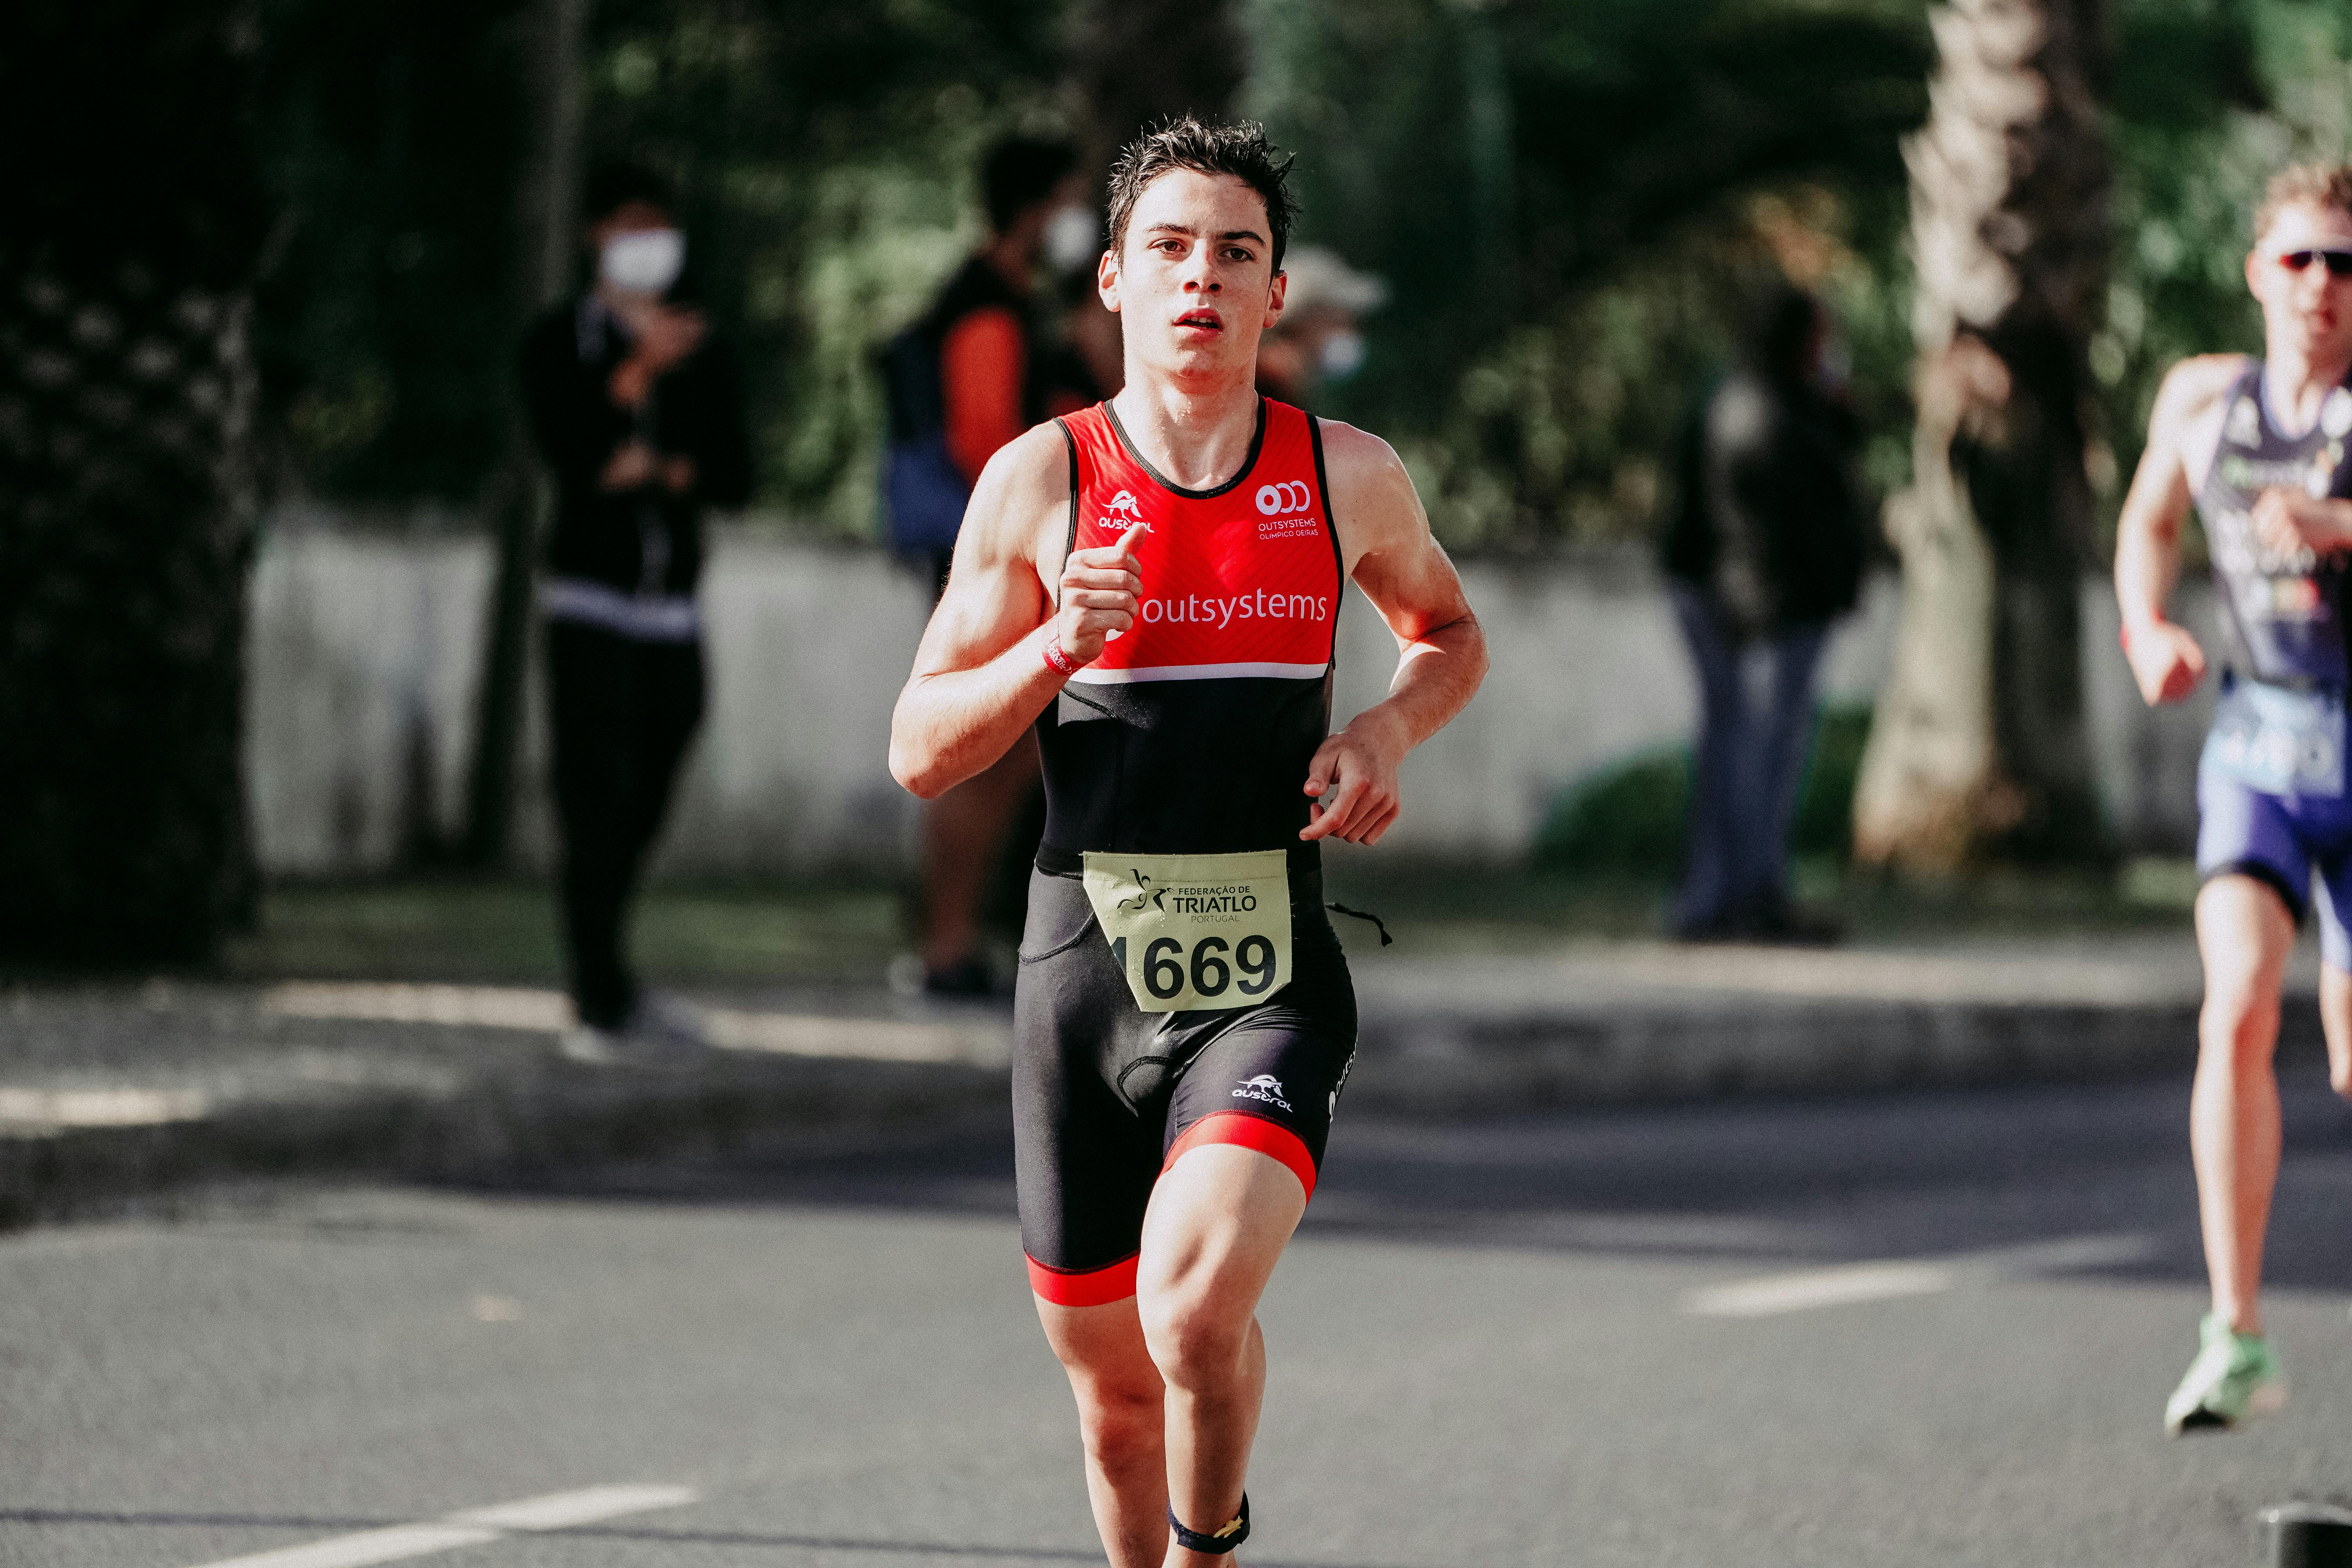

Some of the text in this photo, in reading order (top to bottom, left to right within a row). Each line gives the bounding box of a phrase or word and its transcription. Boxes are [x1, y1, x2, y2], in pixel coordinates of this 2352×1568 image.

[1099, 517, 1154, 533] austl
[1258, 518, 1316, 531] OUTSYSTEMS
[1259, 531, 1294, 540] OLIMPICO
[1142, 588, 1327, 630] outsystems
[1179, 886, 1236, 896] FEDERAÇÃO
[1172, 895, 1256, 913] TRIATLO
[1191, 915, 1240, 923] PORTUGAL
[1232, 1089, 1293, 1113] austral
